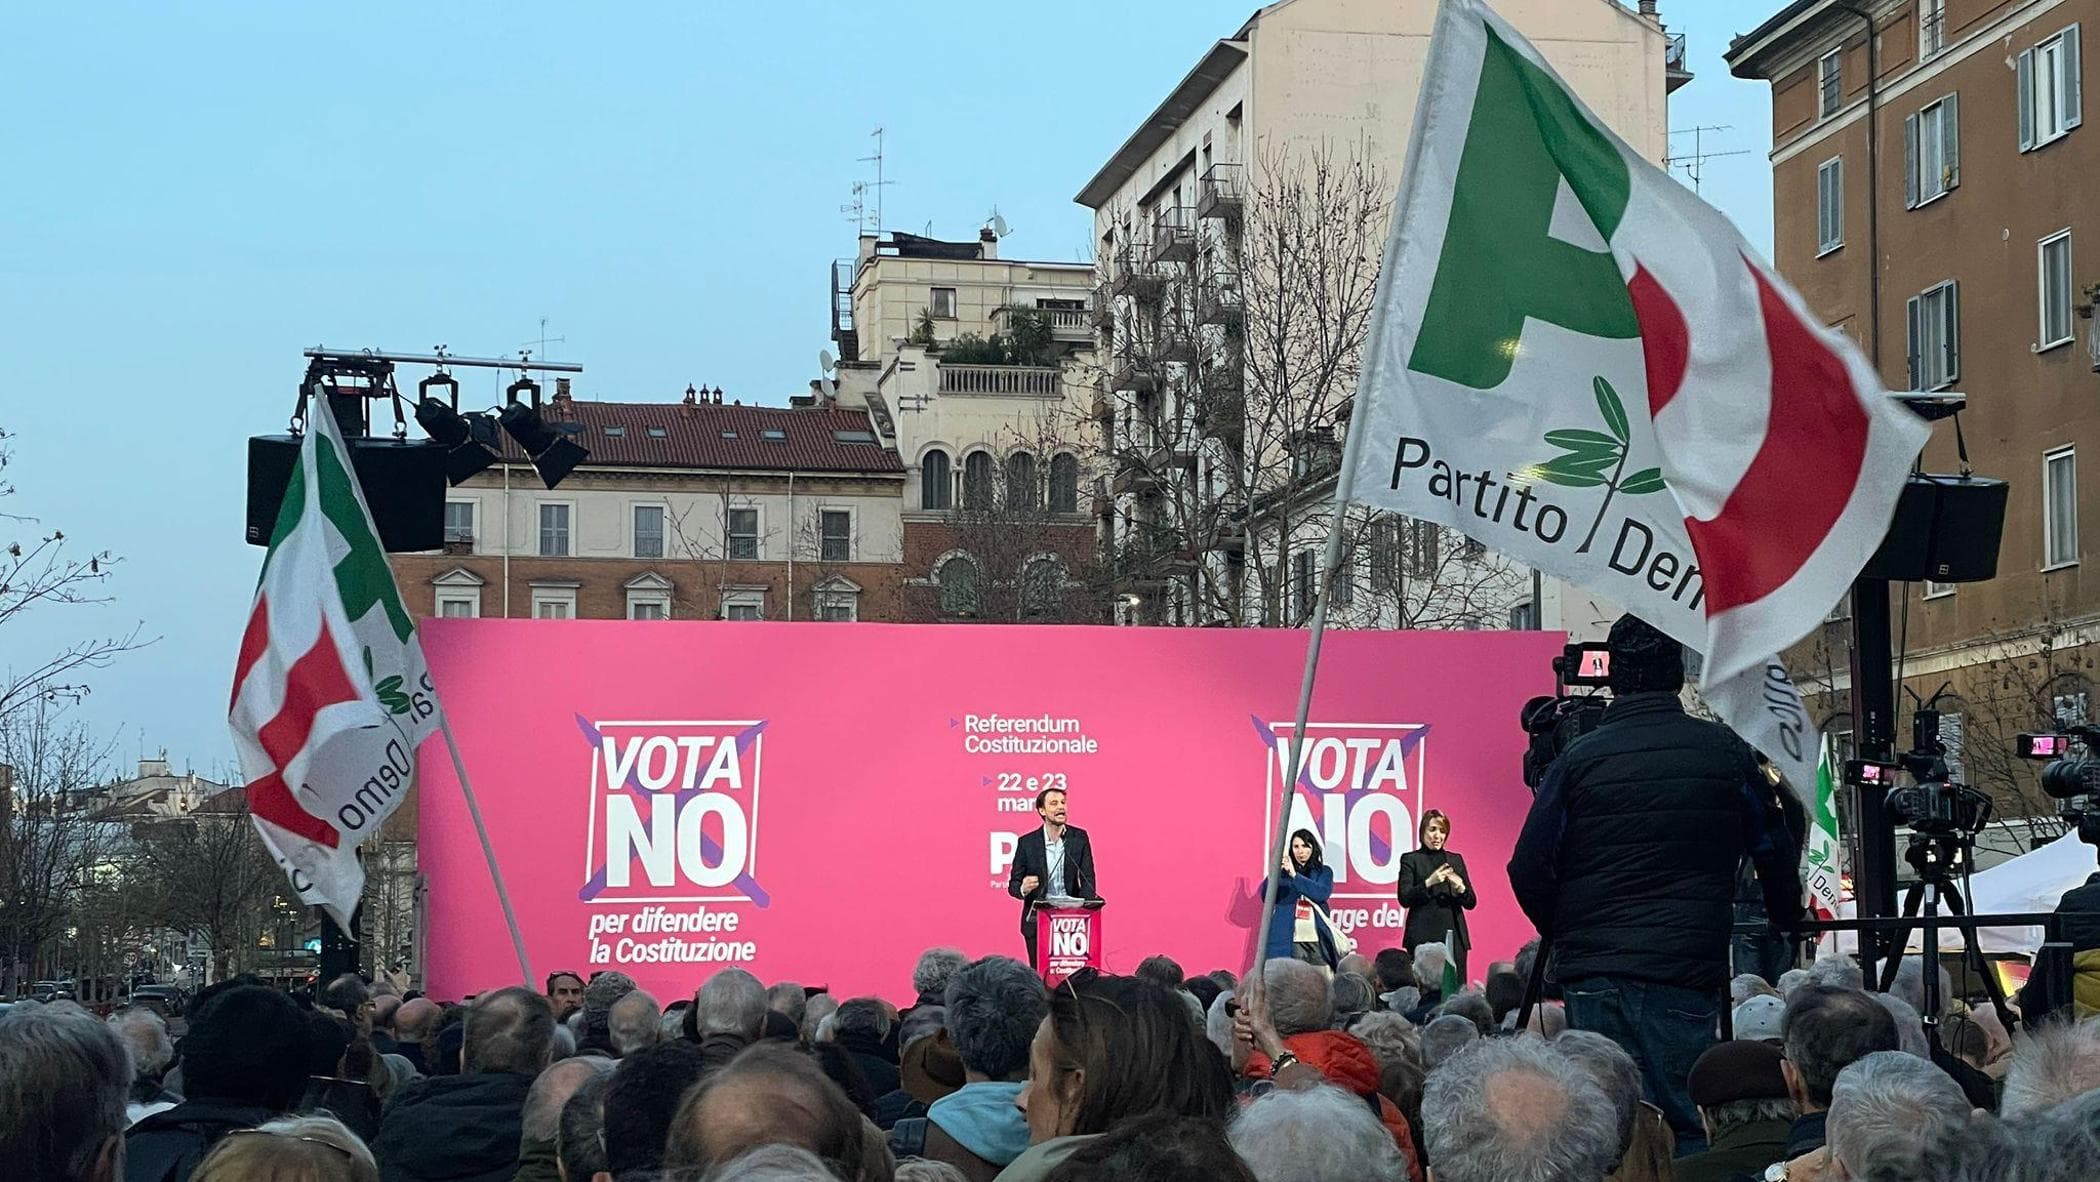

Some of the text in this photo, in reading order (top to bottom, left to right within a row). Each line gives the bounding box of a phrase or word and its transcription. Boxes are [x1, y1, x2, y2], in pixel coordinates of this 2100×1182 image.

[1390, 437, 1568, 543] Partito
[964, 714, 1080, 733] Referendum
[964, 734, 1098, 753] Costituzionale
[601, 735, 742, 790] VOTA
[1276, 737, 1407, 790] VOTA
[997, 772, 1067, 791] 22 e 23
[997, 797, 1037, 812] mar
[606, 792, 748, 888] NO
[990, 831, 1019, 875] P
[1281, 792, 1413, 885] NO
[588, 906, 739, 939] per difendere
[1052, 918, 1087, 932] VOTA
[1330, 902, 1405, 933] gge del
[590, 935, 756, 963] la Costituzione
[1053, 933, 1087, 956] NO
